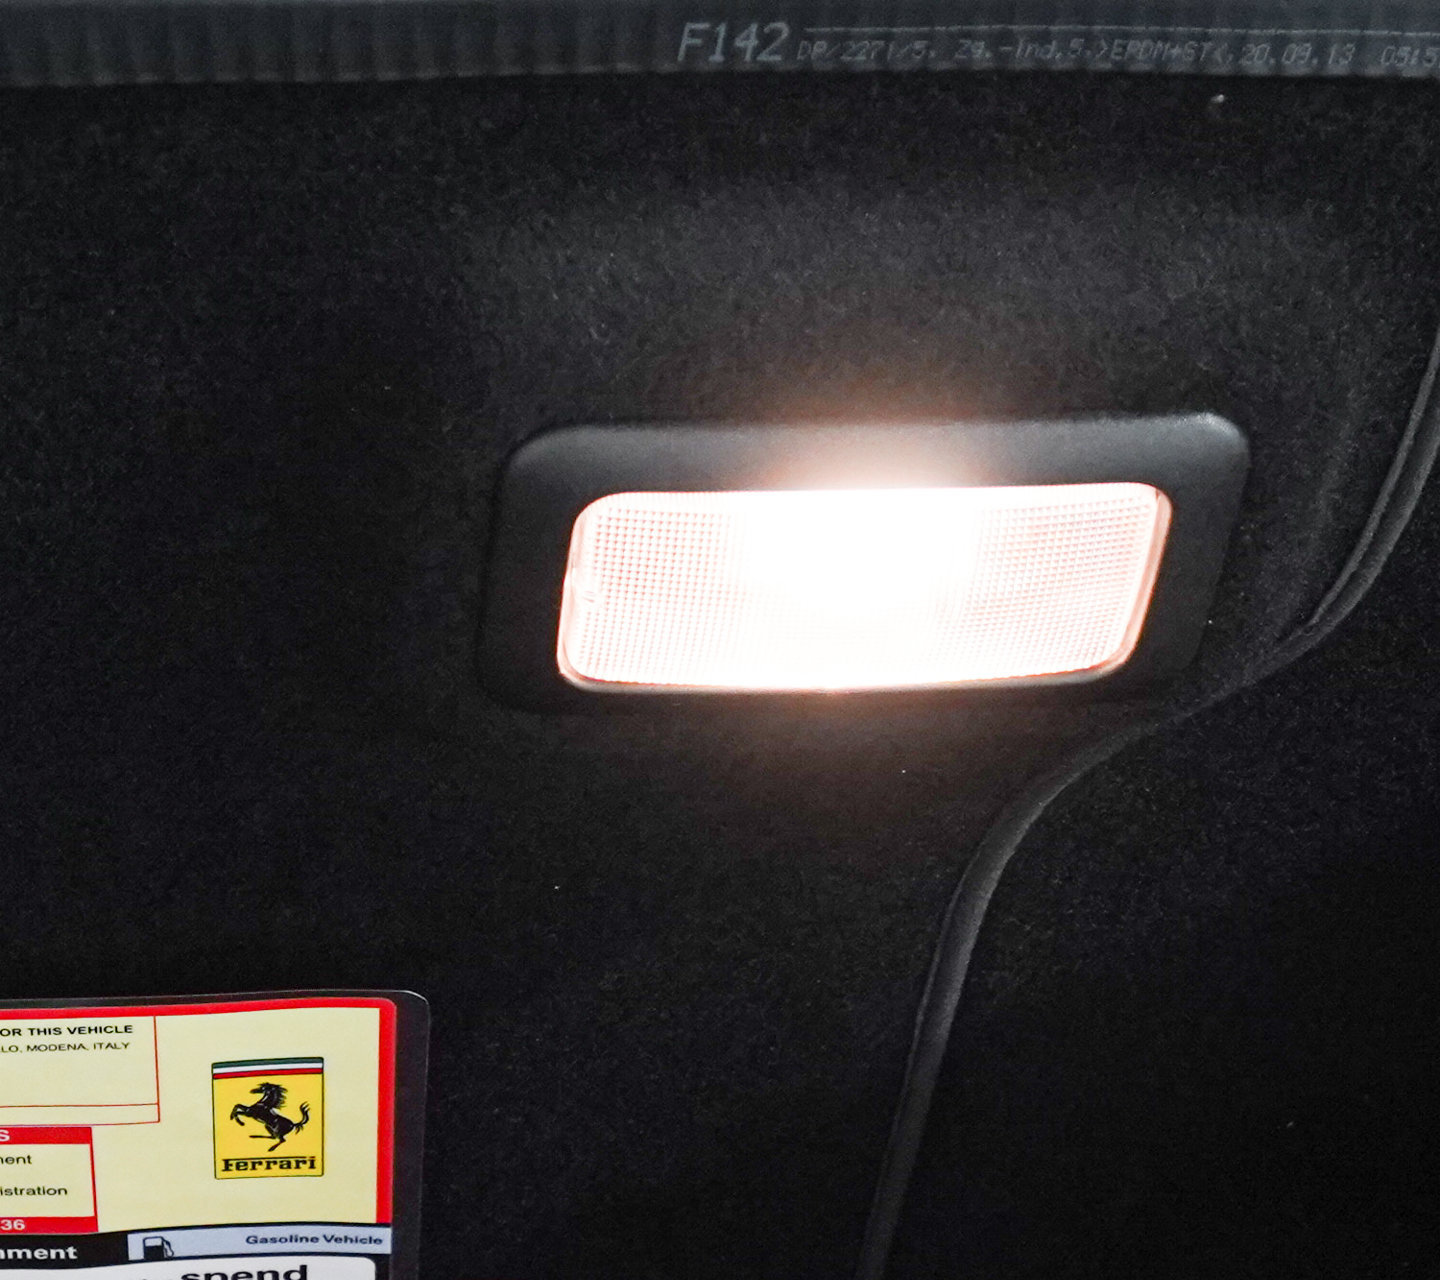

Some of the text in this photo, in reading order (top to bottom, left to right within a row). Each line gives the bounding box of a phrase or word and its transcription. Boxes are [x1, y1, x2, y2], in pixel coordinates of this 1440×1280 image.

[677, 21, 790, 62] F142
[27, 1027, 63, 1037] THIS
[66, 1025, 133, 1035] VEHICLE
[92, 1042, 130, 1050] ITALY
[221, 1155, 317, 1174] Ferrari
[244, 1234, 383, 1245] Gasoline Vehicle
